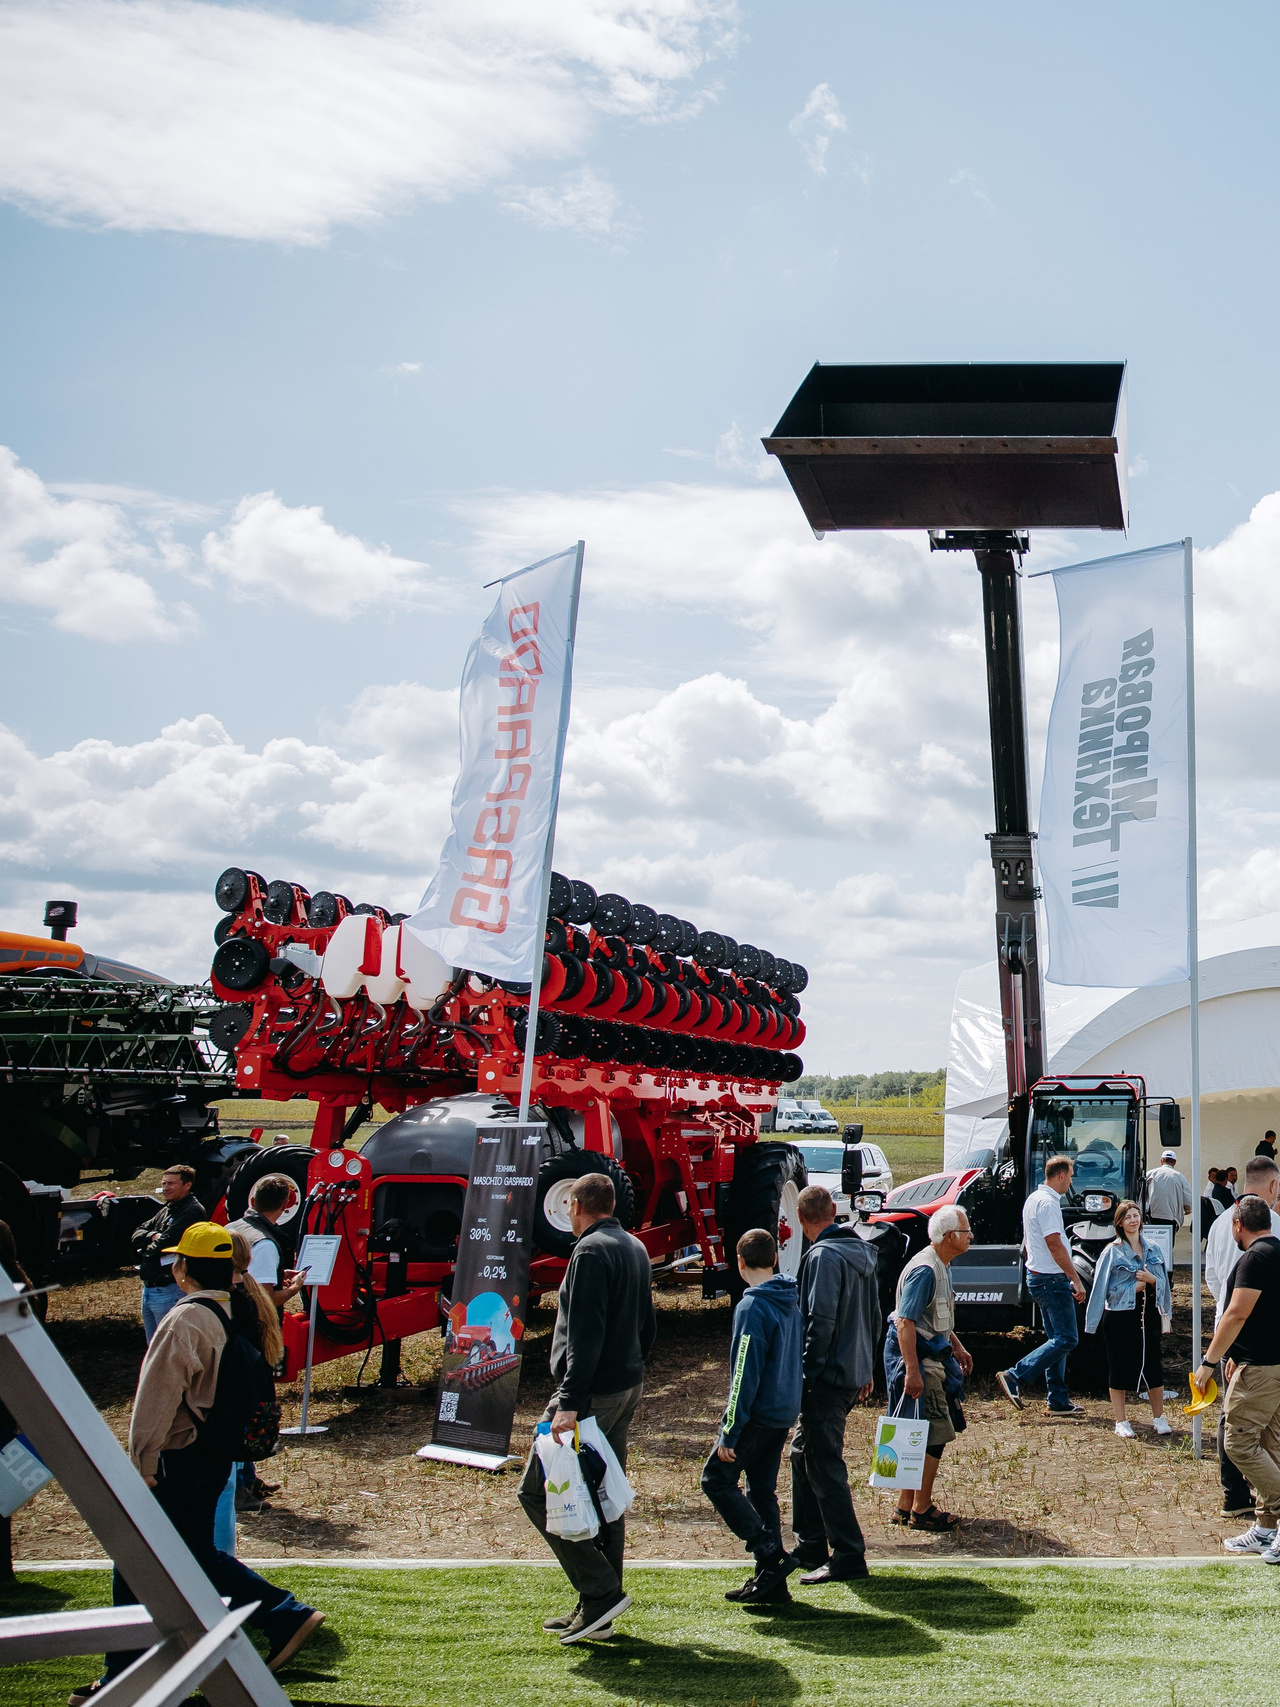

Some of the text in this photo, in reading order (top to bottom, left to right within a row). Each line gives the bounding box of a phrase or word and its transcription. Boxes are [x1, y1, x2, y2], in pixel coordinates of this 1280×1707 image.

[495, 1165, 516, 1173] ТЕХНИКА
[473, 1176, 533, 1186] MASCHIO GASPARDO
[469, 1228, 491, 1241] 30%
[506, 1230, 516, 1242] 12
[483, 1265, 507, 1280] 0,2%
[954, 1292, 1003, 1302] FARESIN
